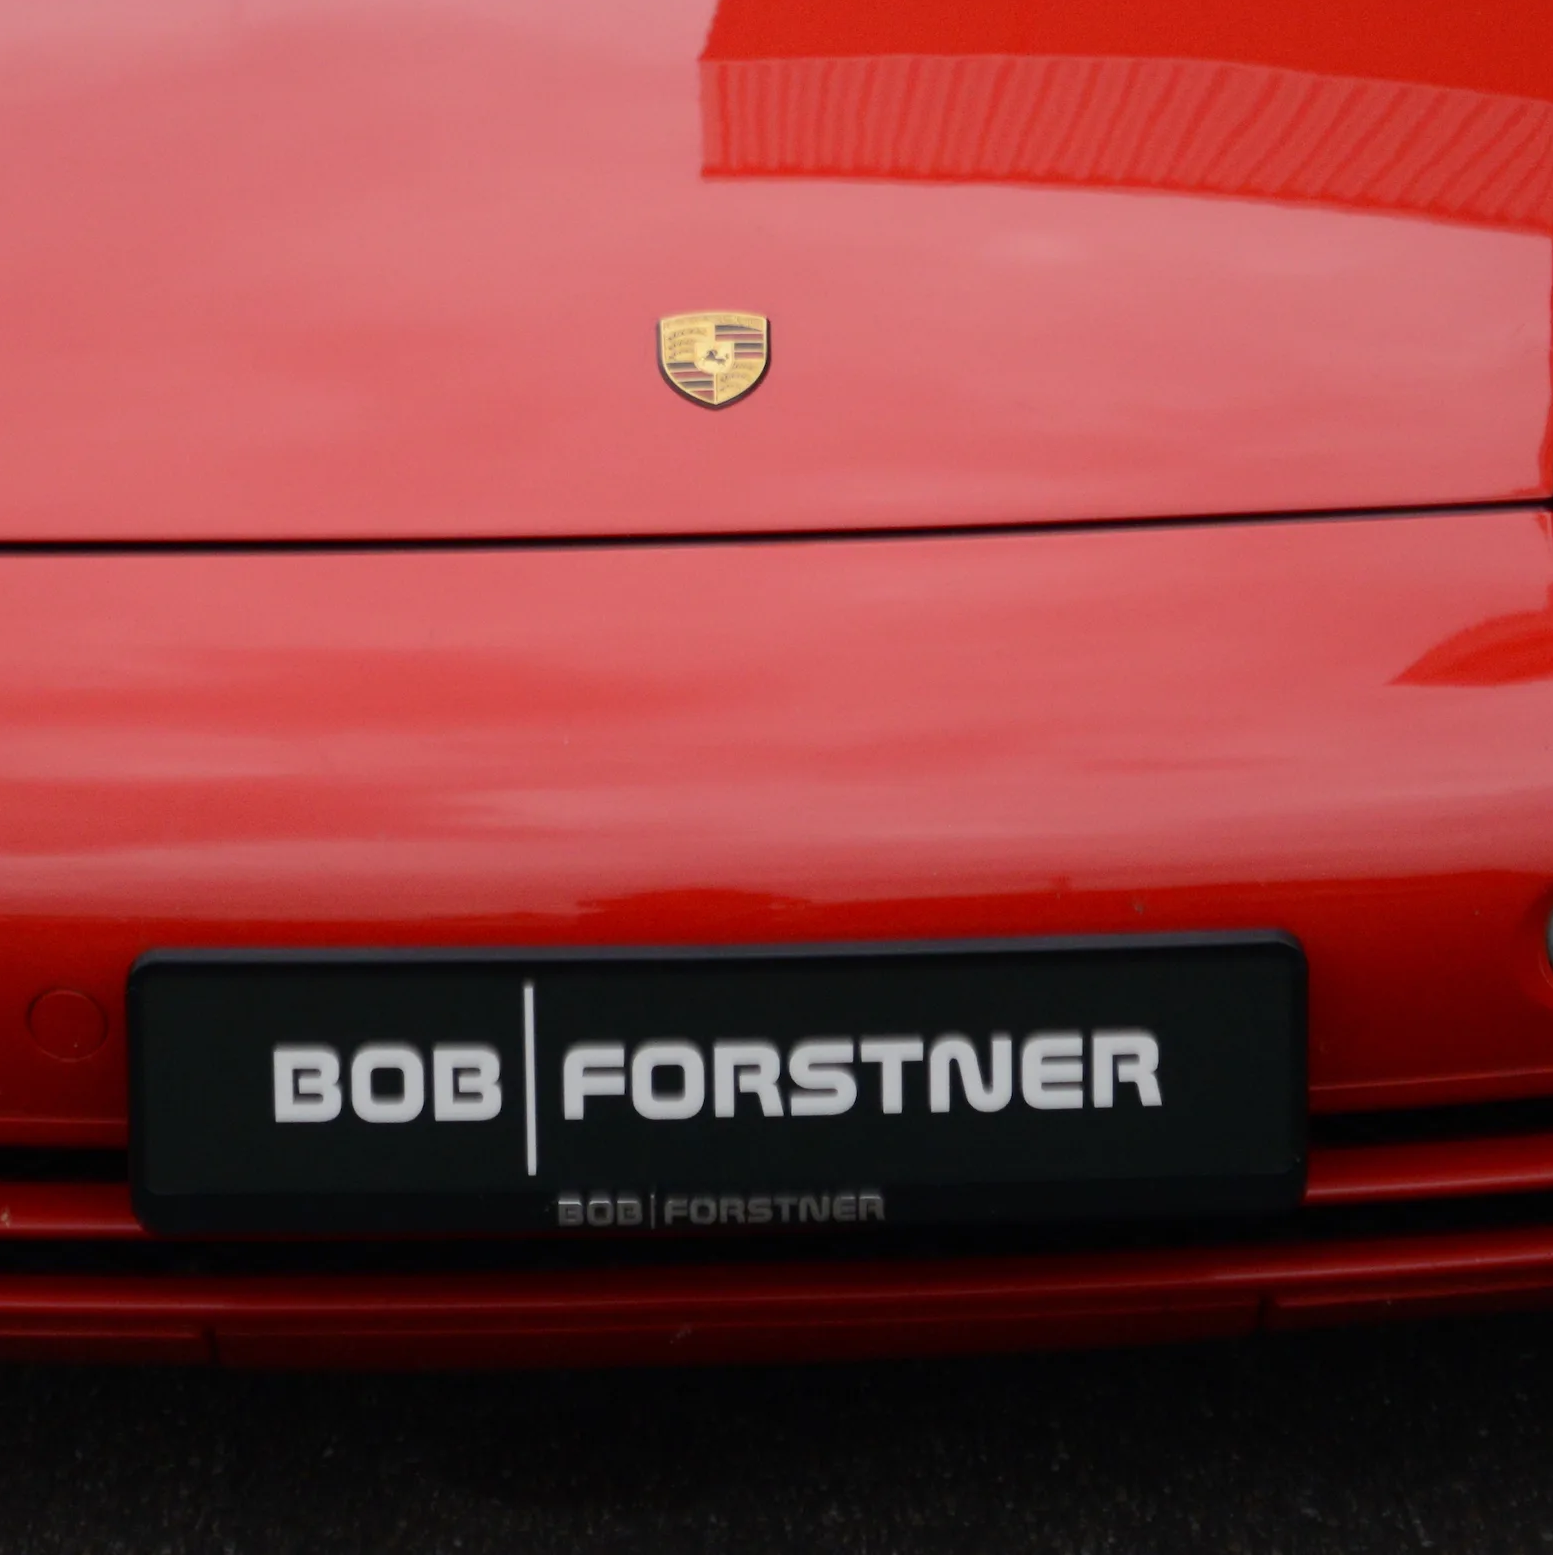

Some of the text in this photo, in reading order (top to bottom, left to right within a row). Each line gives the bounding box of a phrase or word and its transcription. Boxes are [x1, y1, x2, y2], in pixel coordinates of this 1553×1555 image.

[271, 1030, 1164, 1124] BOB FORSTNER
[557, 1194, 886, 1227] BOB FORSTNER
